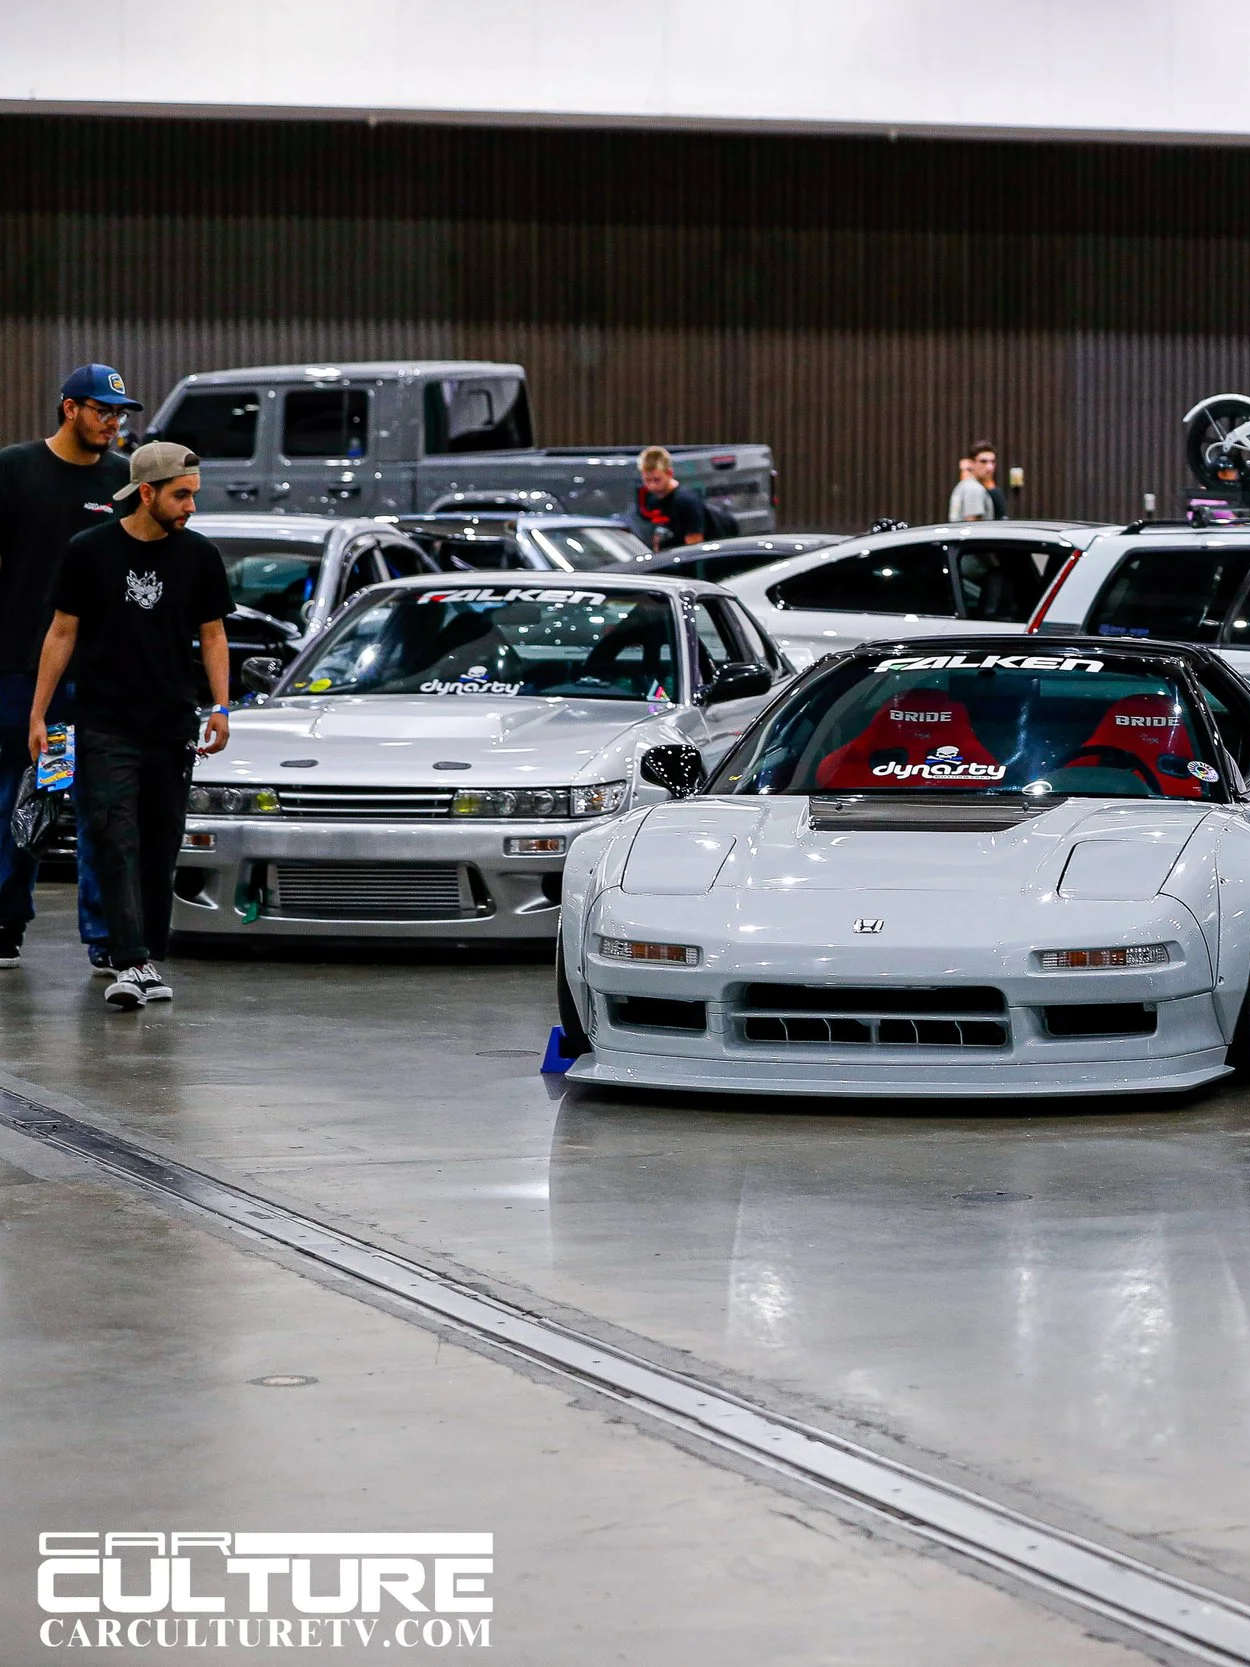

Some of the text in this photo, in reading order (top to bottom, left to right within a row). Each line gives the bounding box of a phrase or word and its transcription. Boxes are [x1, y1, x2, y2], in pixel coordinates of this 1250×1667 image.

[417, 589, 606, 605] FALKEN
[871, 656, 1104, 673] FALKEN
[420, 678, 521, 697] dynasty
[889, 709, 953, 722] BRIDE
[1115, 715, 1180, 727] BRIDE
[872, 761, 1007, 780] dynasty
